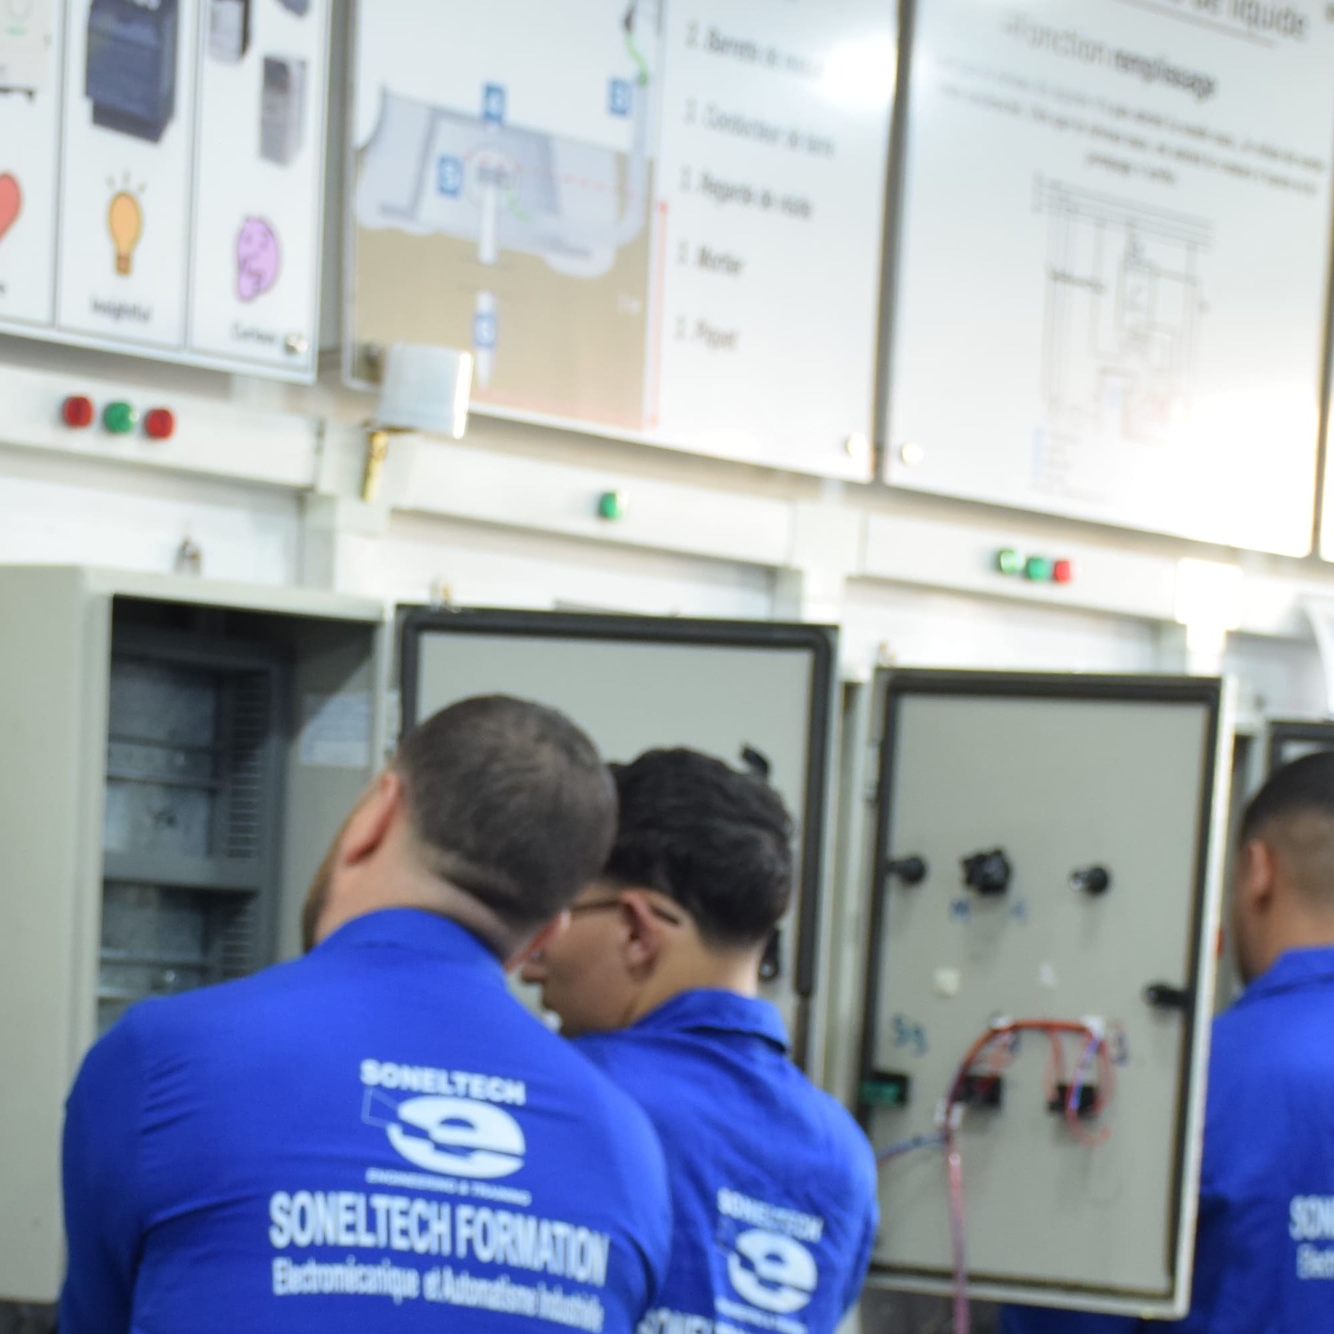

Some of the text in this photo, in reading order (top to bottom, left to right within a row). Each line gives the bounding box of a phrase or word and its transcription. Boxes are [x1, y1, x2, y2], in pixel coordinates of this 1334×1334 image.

[360, 1058, 527, 1107] SONELTECH
[269, 1189, 611, 1289] SONELTECH FORMATION
